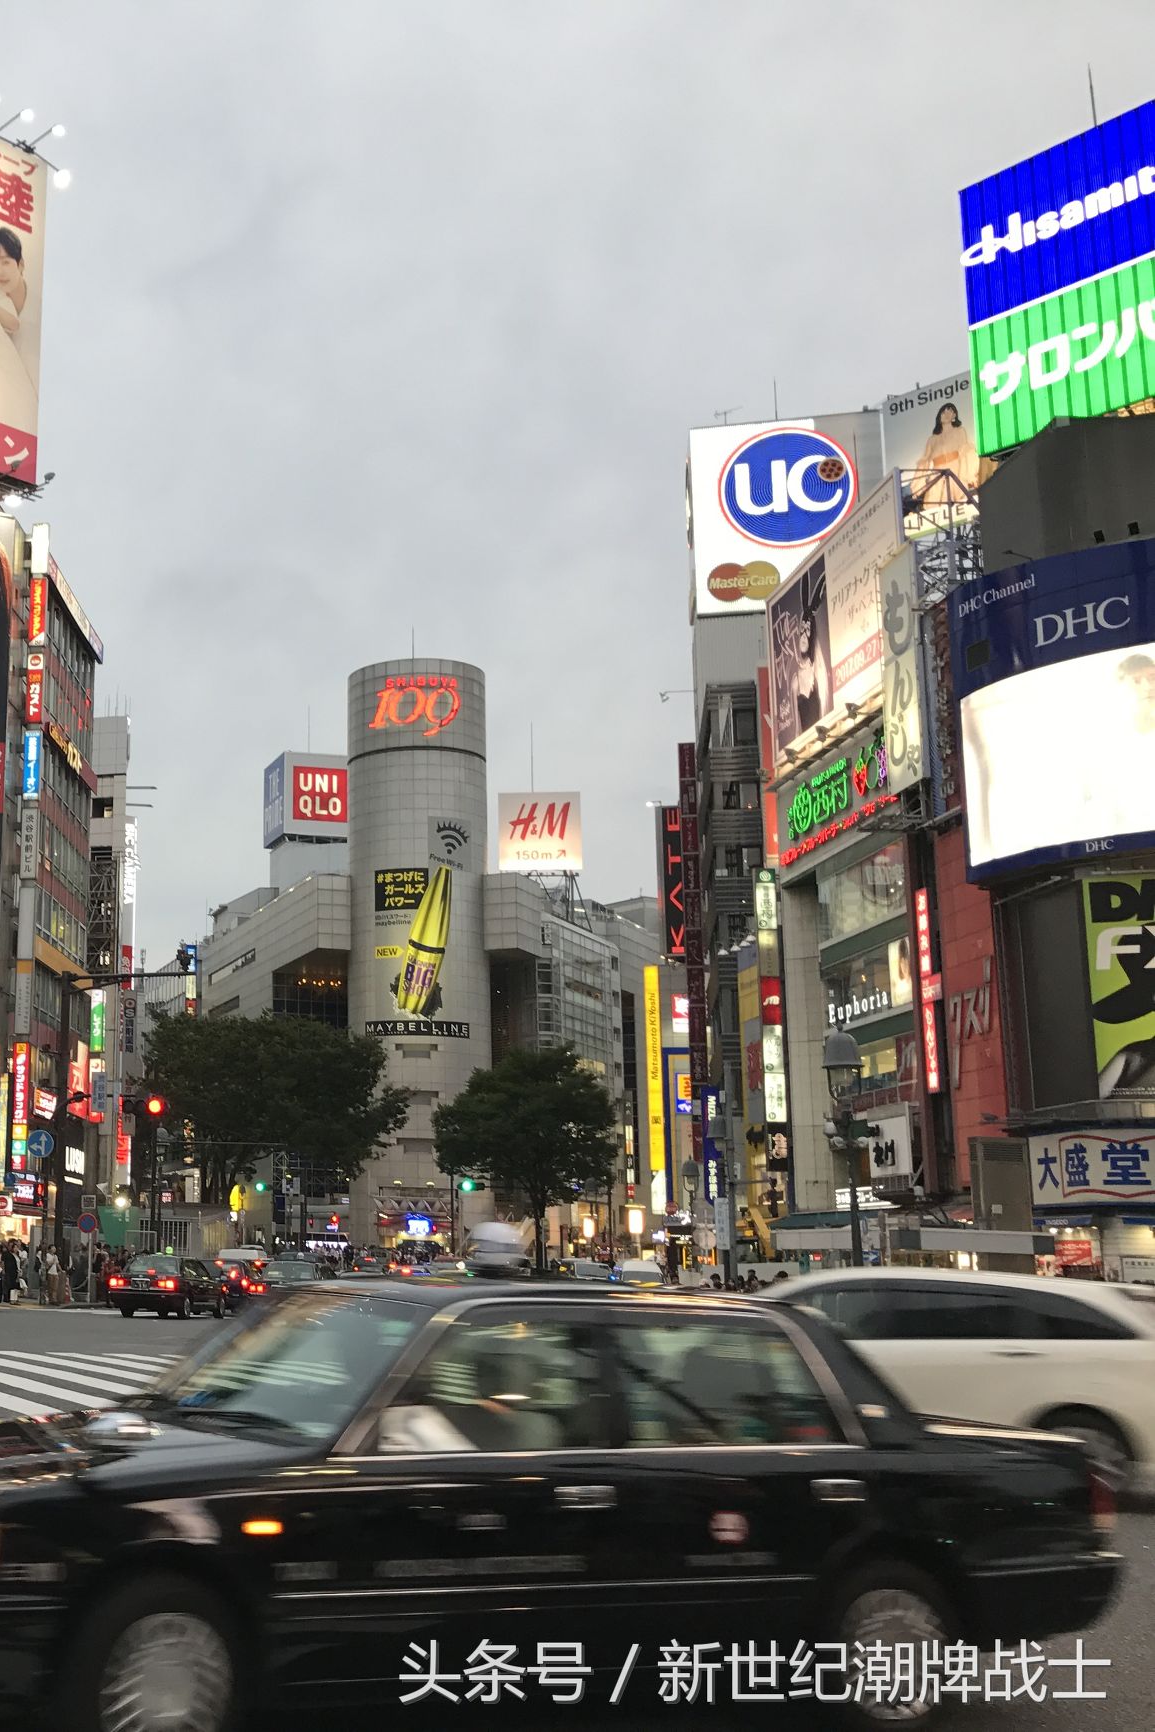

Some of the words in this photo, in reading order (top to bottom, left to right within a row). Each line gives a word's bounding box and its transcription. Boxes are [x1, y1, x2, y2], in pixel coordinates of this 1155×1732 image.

[889, 399, 914, 416] 9th
[918, 378, 970, 405] Single
[708, 570, 780, 592] MasterCard
[958, 591, 980, 618] DHC
[982, 574, 1036, 607] Channel
[1033, 596, 1131, 649] DHC
[386, 675, 458, 688] SHIBUYA
[368, 686, 461, 737] 109
[299, 772, 338, 793] UNI
[299, 794, 342, 818] QLO
[509, 801, 571, 841] H&M
[516, 850, 553, 861] 150m
[1085, 837, 1115, 852] DHC
[377, 871, 424, 883] #まつげに
[385, 883, 425, 895] ガールズ
[666, 809, 684, 955] KATE
[385, 897, 415, 907] パワー
[376, 947, 399, 956] NEW
[404, 963, 434, 988] BIG
[828, 988, 888, 1024] Euphoria
[366, 1022, 469, 1034] MAYBELLINE
[65, 1146, 85, 1175] LUSH
[1037, 1142, 1151, 1191] 大盛堂
